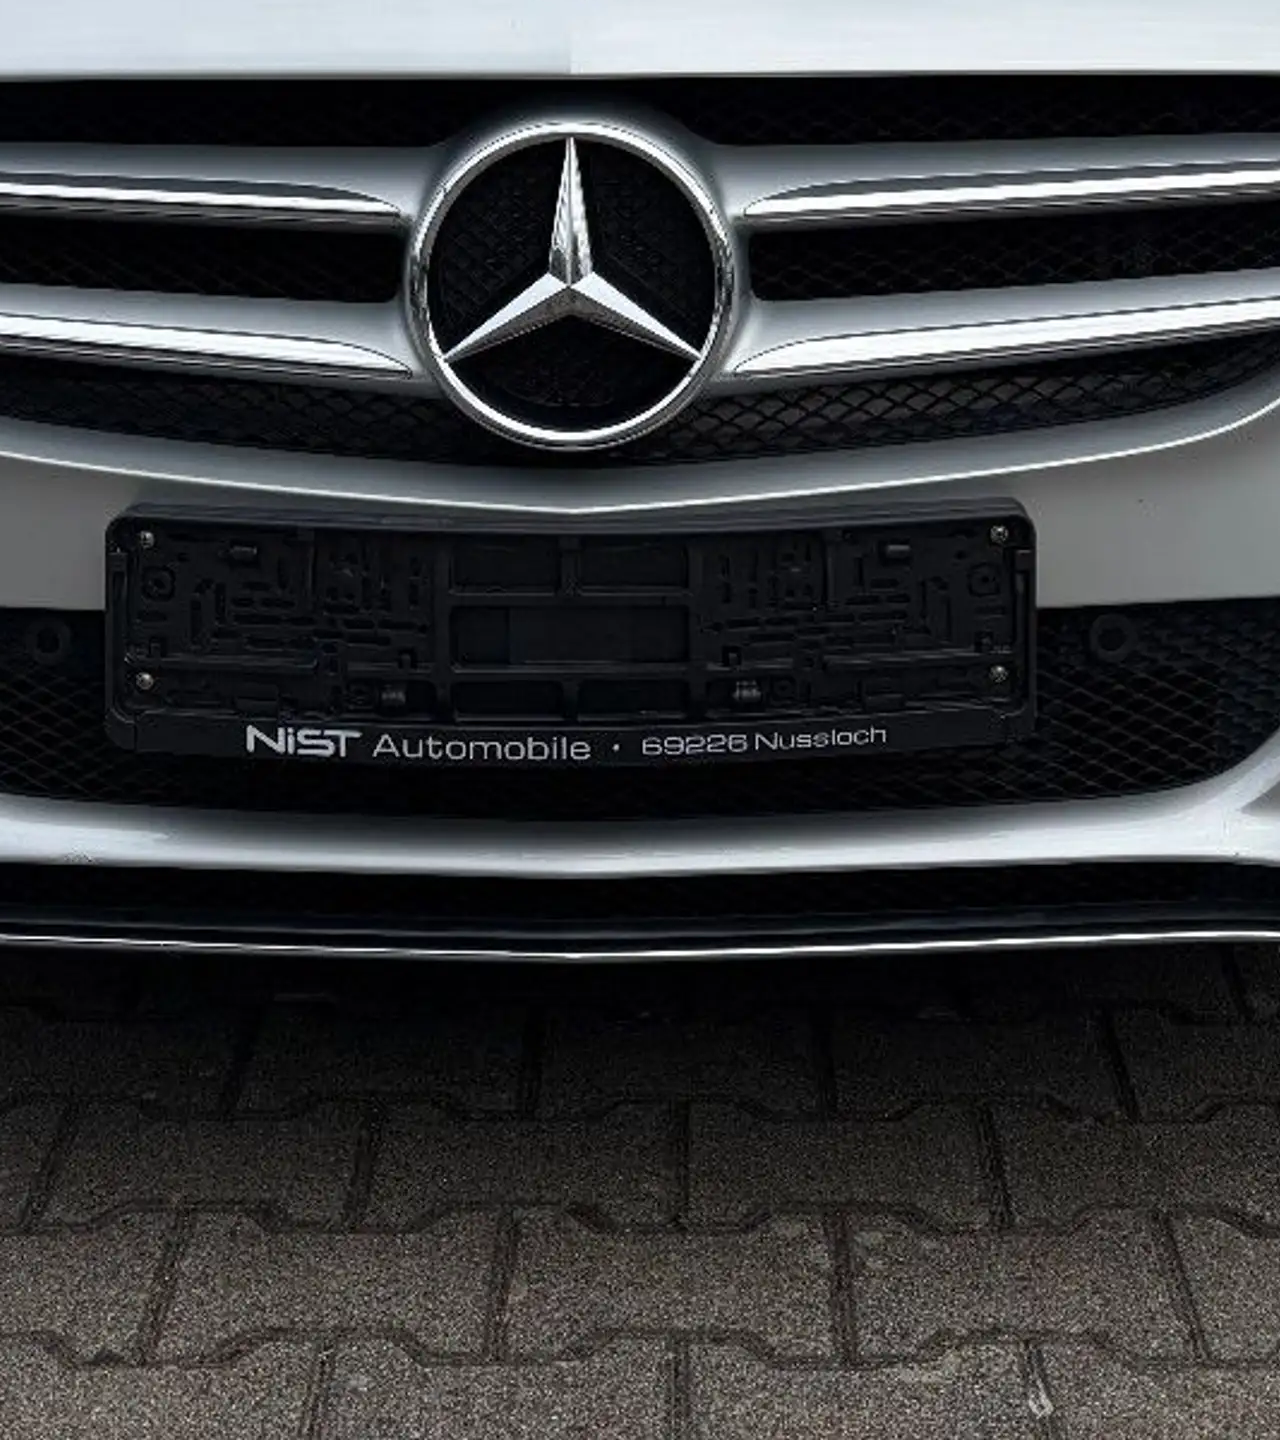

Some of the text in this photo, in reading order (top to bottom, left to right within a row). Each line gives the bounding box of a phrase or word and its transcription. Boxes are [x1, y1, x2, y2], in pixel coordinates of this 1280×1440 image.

[372, 733, 592, 761] Automobile
[642, 733, 749, 756] 69226
[754, 725, 887, 751] Nussloch
